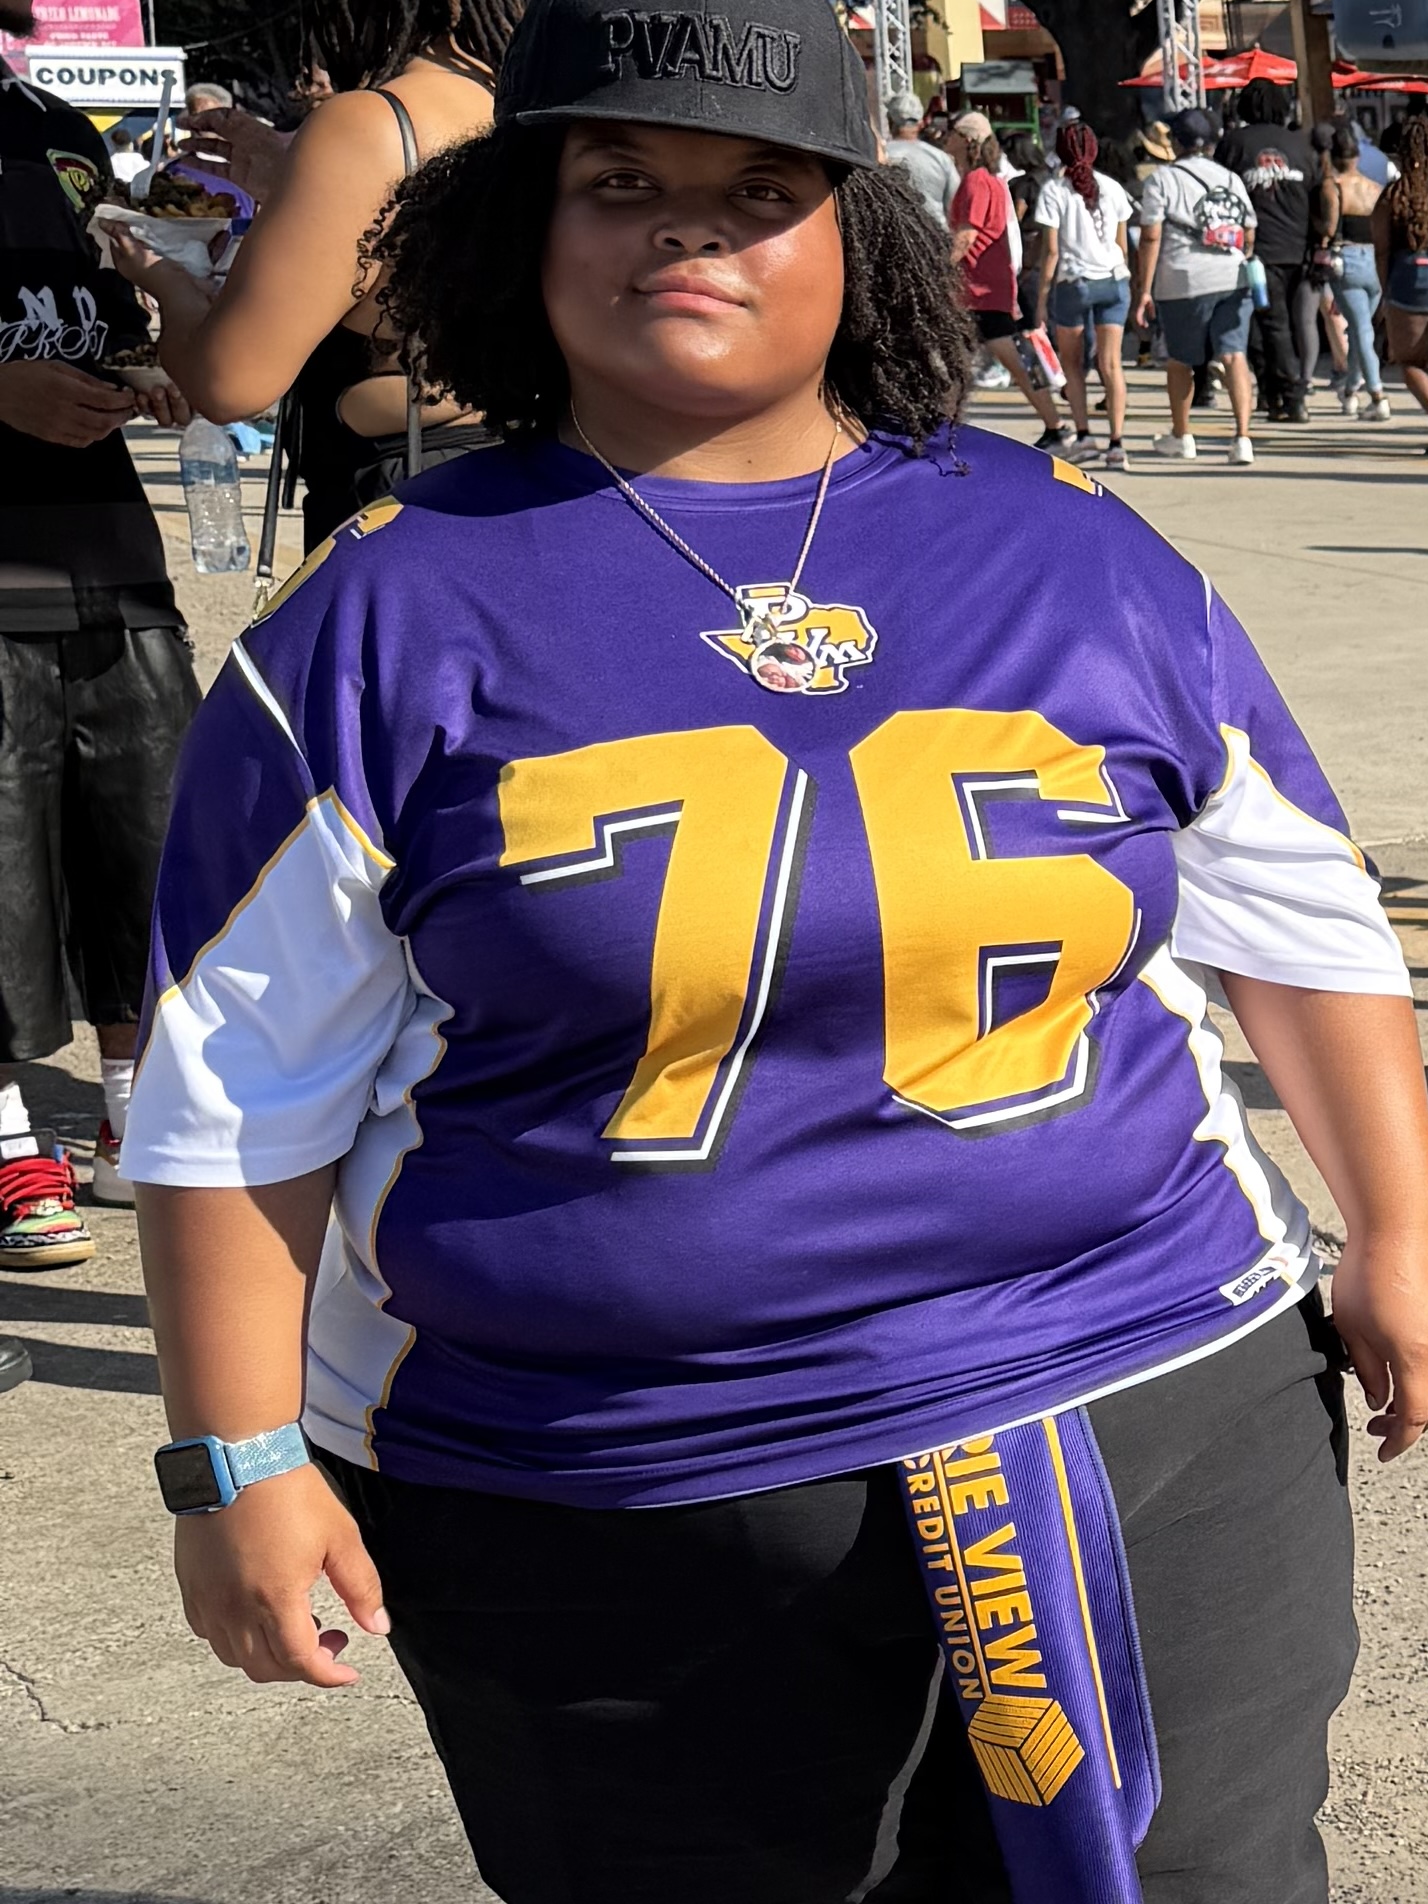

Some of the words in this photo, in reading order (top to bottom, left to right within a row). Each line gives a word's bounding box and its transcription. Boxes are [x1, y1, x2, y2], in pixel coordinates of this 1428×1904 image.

[36, 66, 178, 87] COUPONS
[600, 8, 801, 95] PVAMU
[498, 707, 1142, 1170] 76
[934, 1584, 984, 1699] UNION
[963, 1522, 1048, 1689] VIEW
